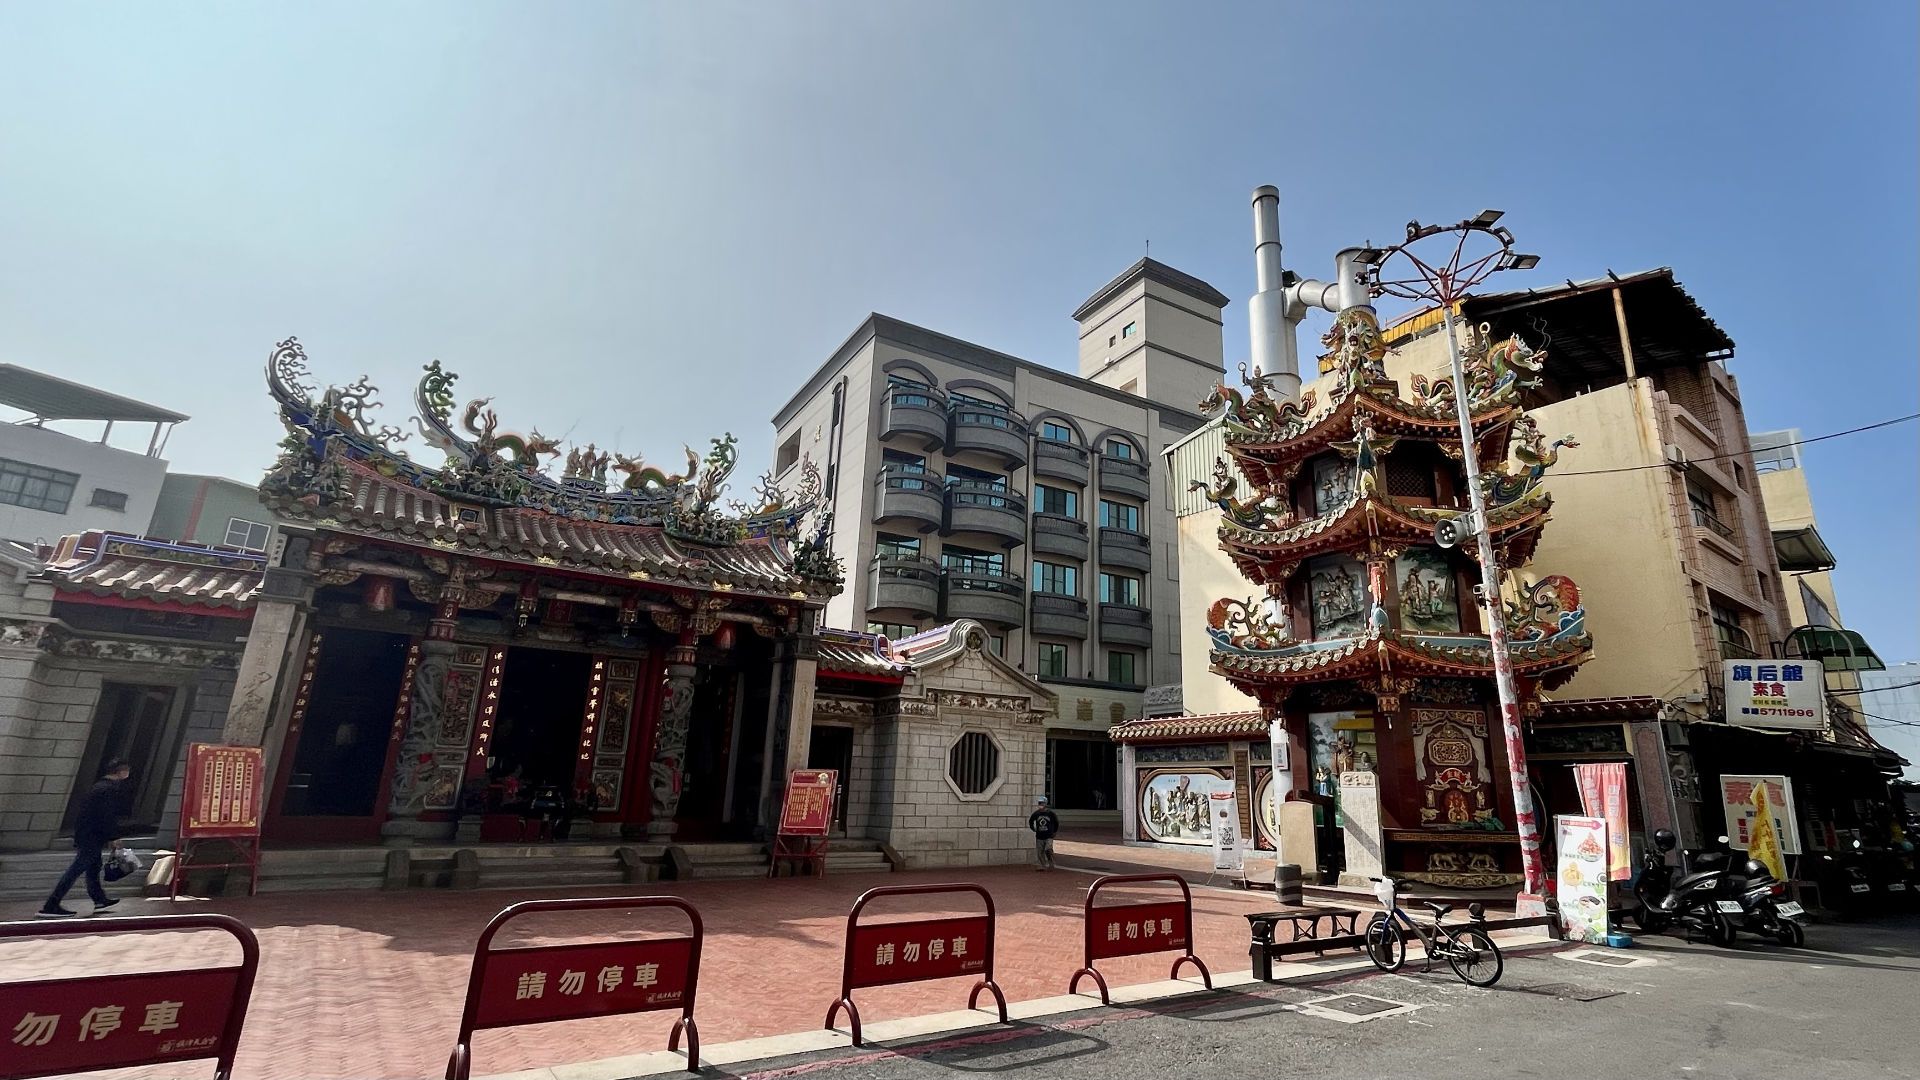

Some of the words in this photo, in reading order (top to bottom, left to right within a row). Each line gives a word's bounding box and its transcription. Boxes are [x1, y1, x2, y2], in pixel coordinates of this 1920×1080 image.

[1732, 665, 1803, 681] 旗后館
[1753, 682, 1786, 697] 素食
[1107, 918, 1173, 941] 請勿停車
[876, 936, 968, 966] 請勿停車
[516, 962, 660, 1000] 請勿停車
[11, 1000, 184, 1047] 勿停車
